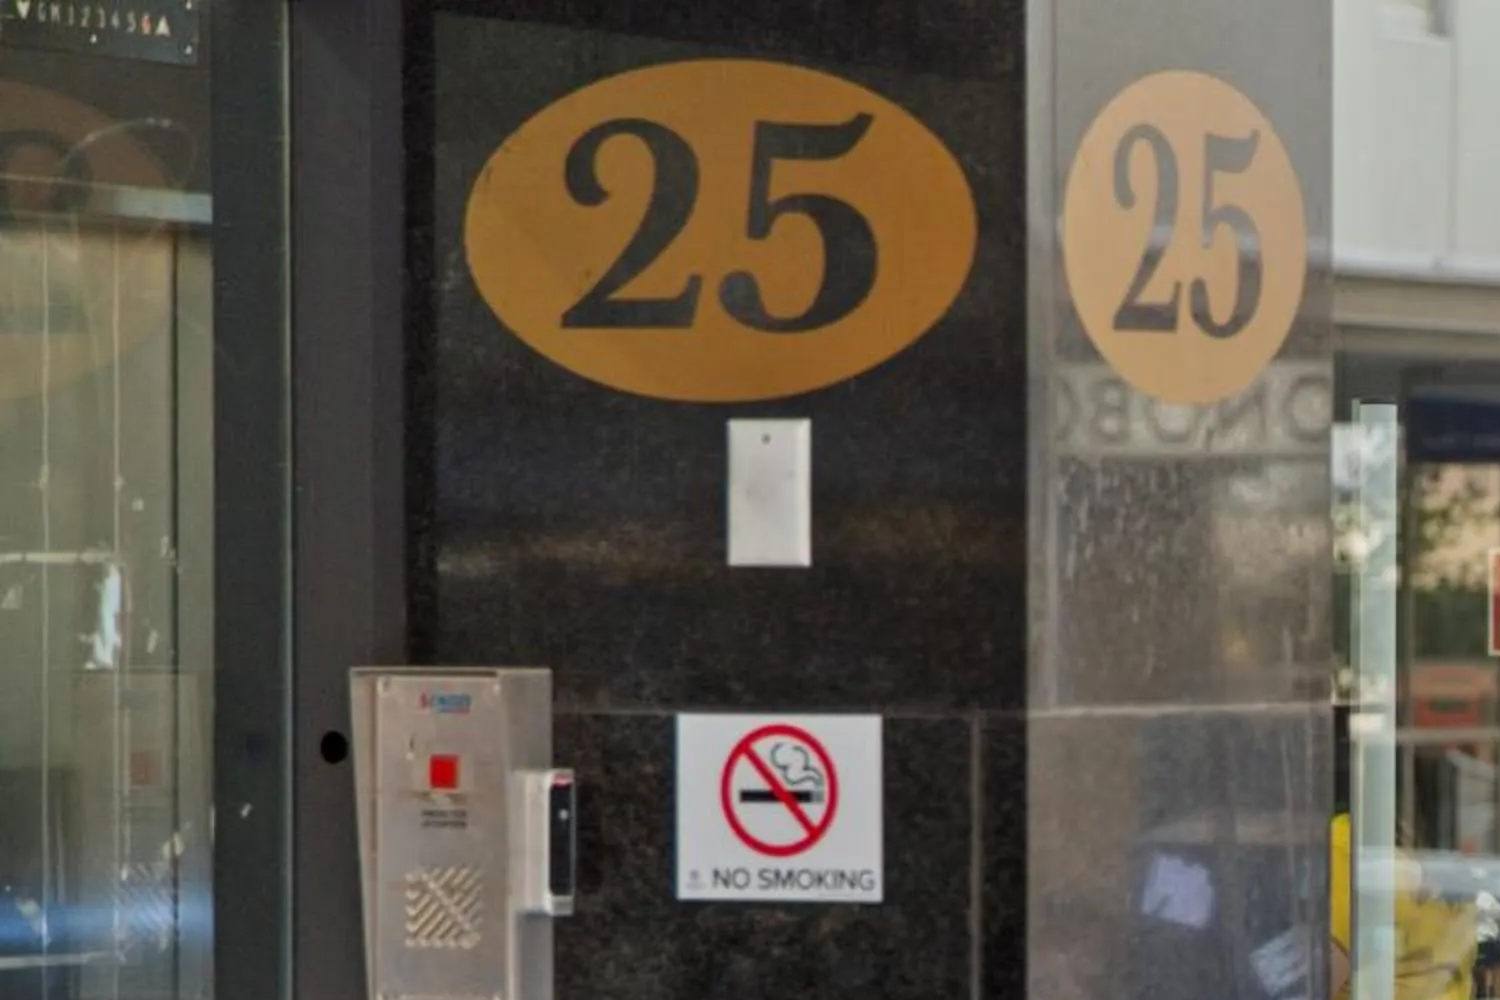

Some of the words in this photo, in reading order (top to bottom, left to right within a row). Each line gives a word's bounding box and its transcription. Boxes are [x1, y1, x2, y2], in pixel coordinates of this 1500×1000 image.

[560, 111, 879, 334] 25
[1112, 122, 1264, 340] 25
[712, 867, 751, 891] NO
[757, 867, 876, 892] SMOKING
